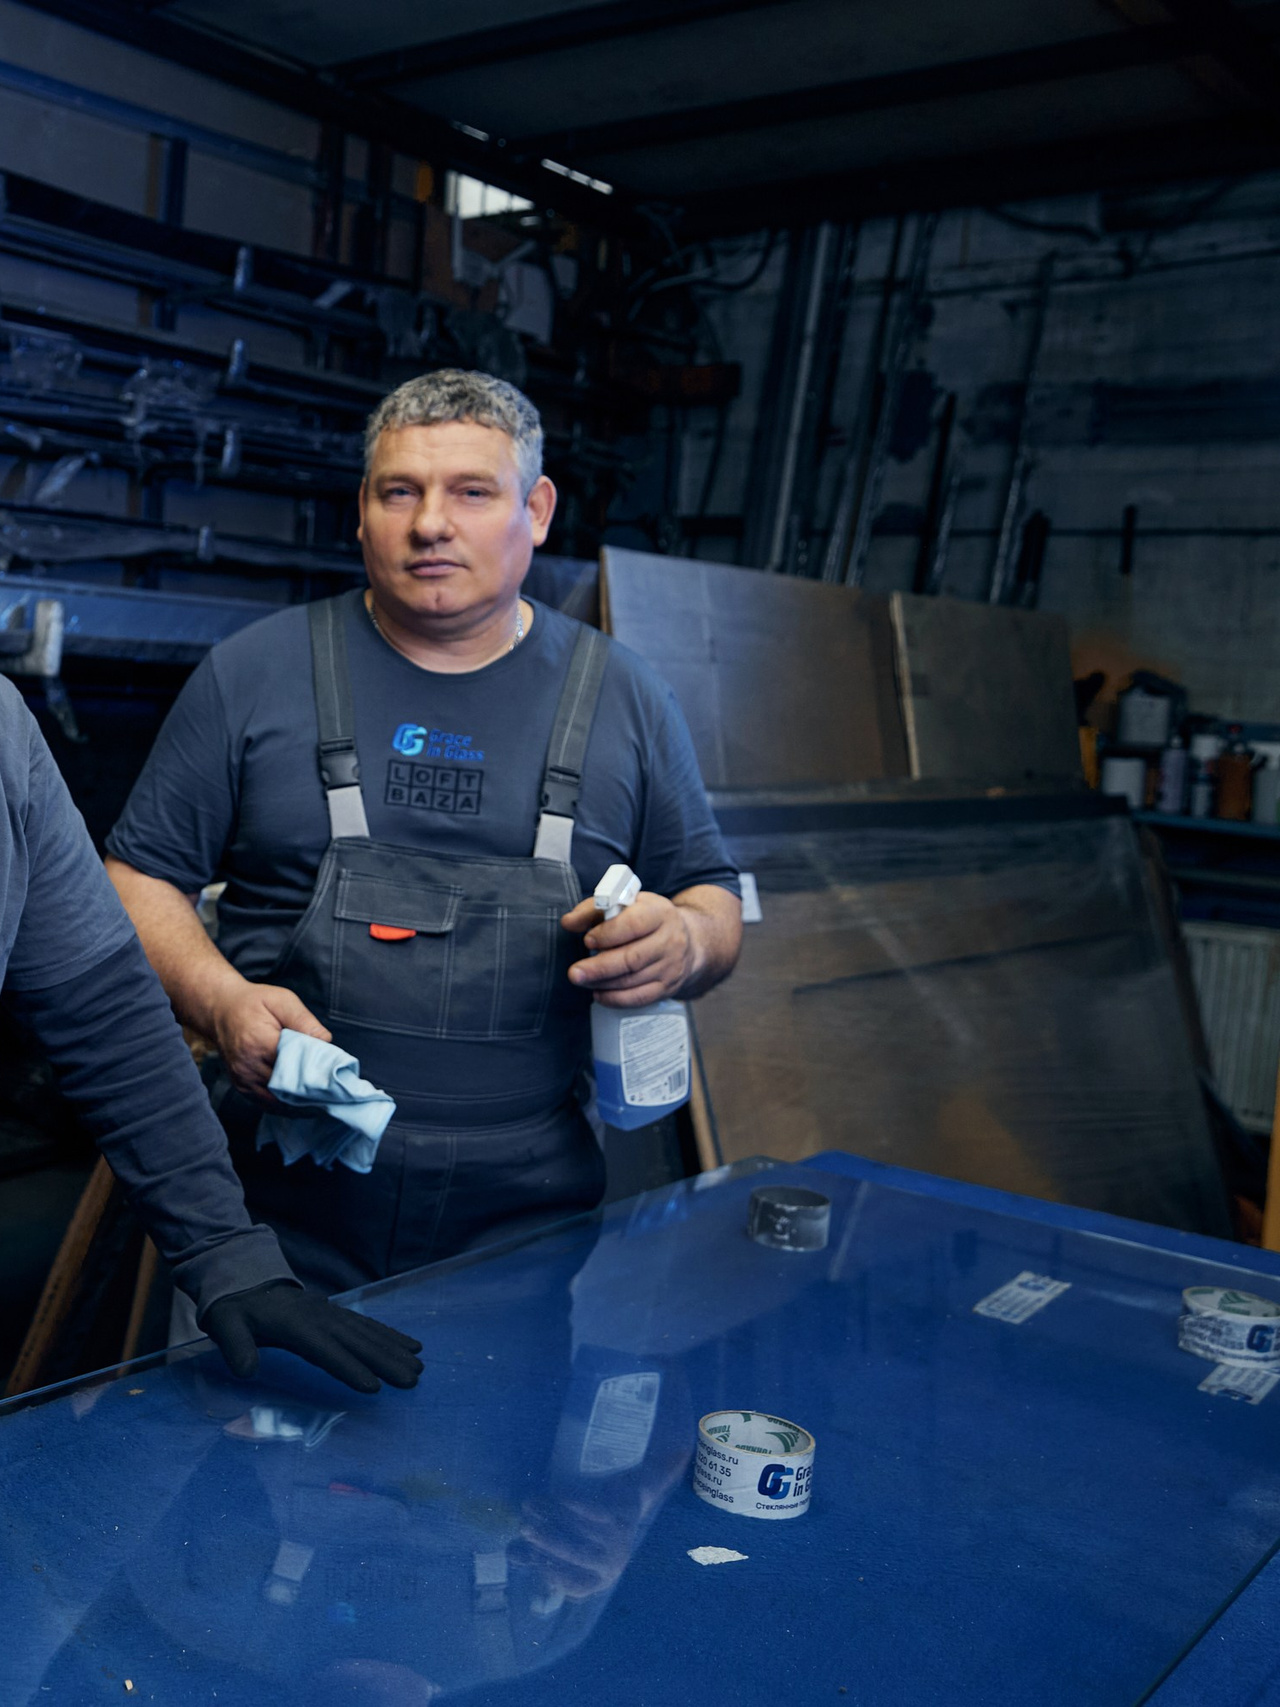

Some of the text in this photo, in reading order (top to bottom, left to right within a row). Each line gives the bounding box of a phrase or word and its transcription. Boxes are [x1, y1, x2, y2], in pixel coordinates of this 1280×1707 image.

[428, 728, 473, 747] Grace
[427, 744, 486, 761] in Glass
[395, 767, 475, 787] LOFT
[392, 789, 473, 808] BAZA
[708, 1460, 718, 1472] 61
[719, 1465, 731, 1477] 35
[793, 1482, 804, 1497] in
